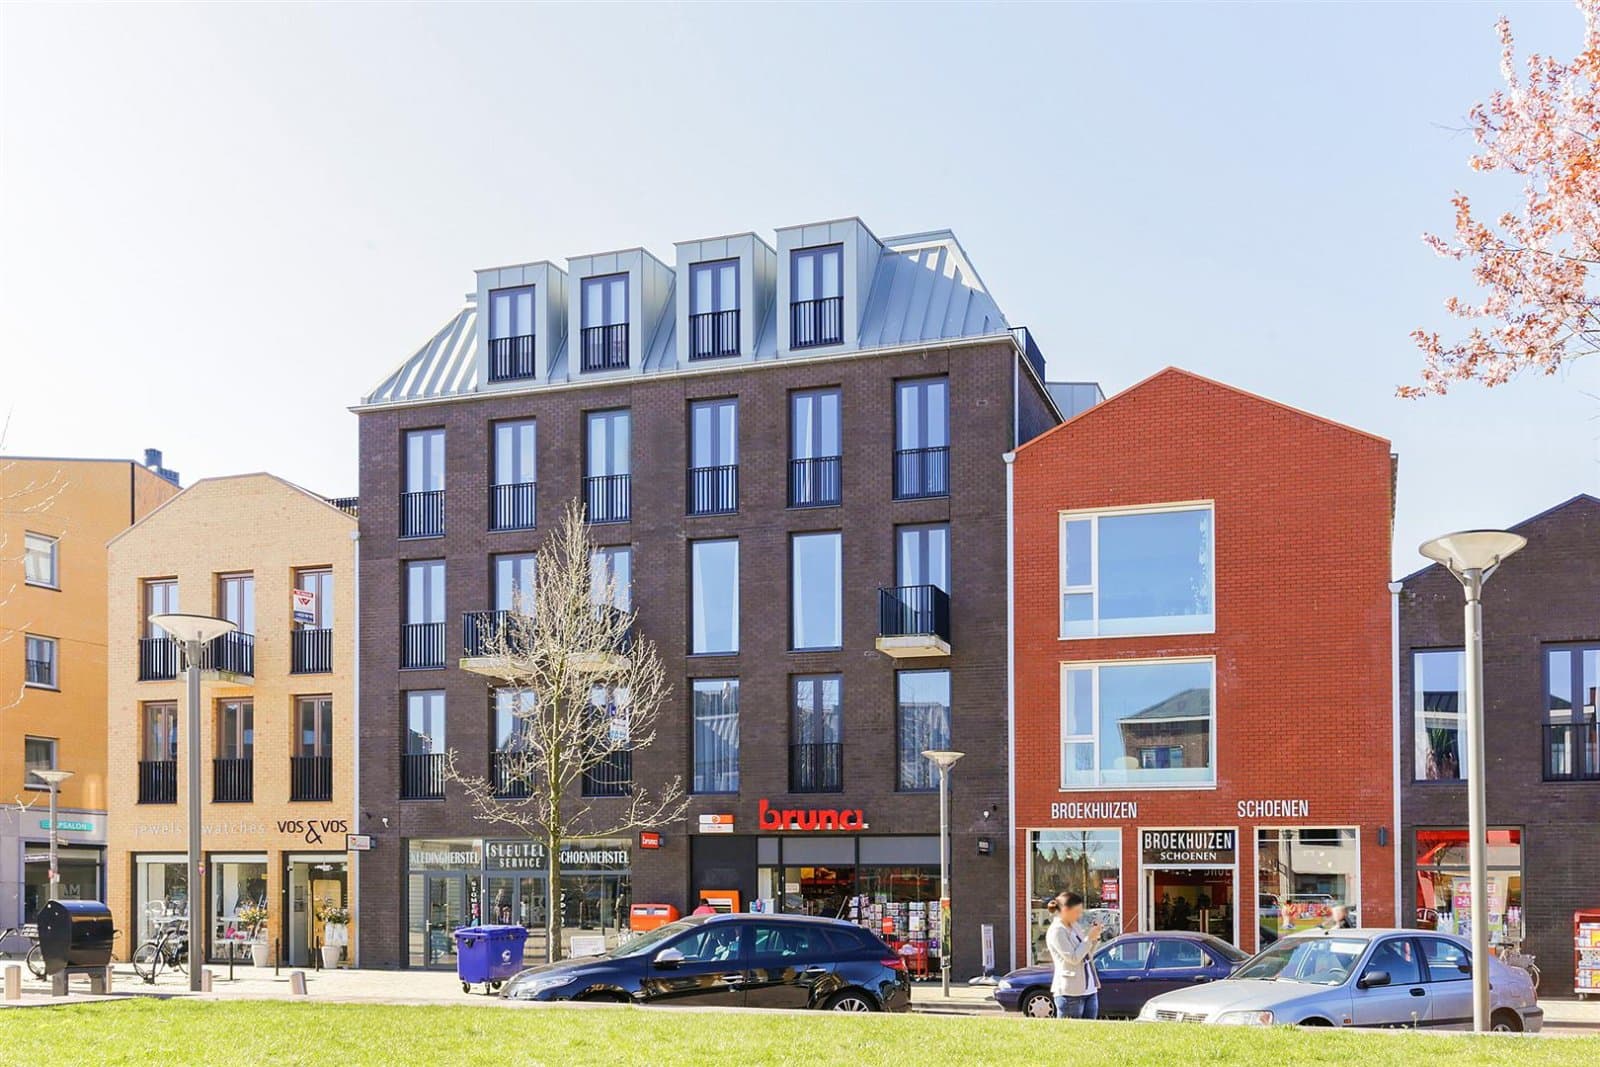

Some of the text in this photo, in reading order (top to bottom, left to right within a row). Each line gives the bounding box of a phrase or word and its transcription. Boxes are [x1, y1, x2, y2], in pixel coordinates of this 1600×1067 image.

[759, 797, 864, 831] bruna
[1051, 799, 1309, 819] BROEKHUIZEN SCHOENEN
[277, 820, 347, 844] VOS & VOS
[1144, 832, 1232, 849] BROEKHUIZEN
[490, 843, 545, 857] SLEUTEL
[1160, 851, 1217, 861] SCHOENEN
[500, 857, 540, 868] SERVICE
